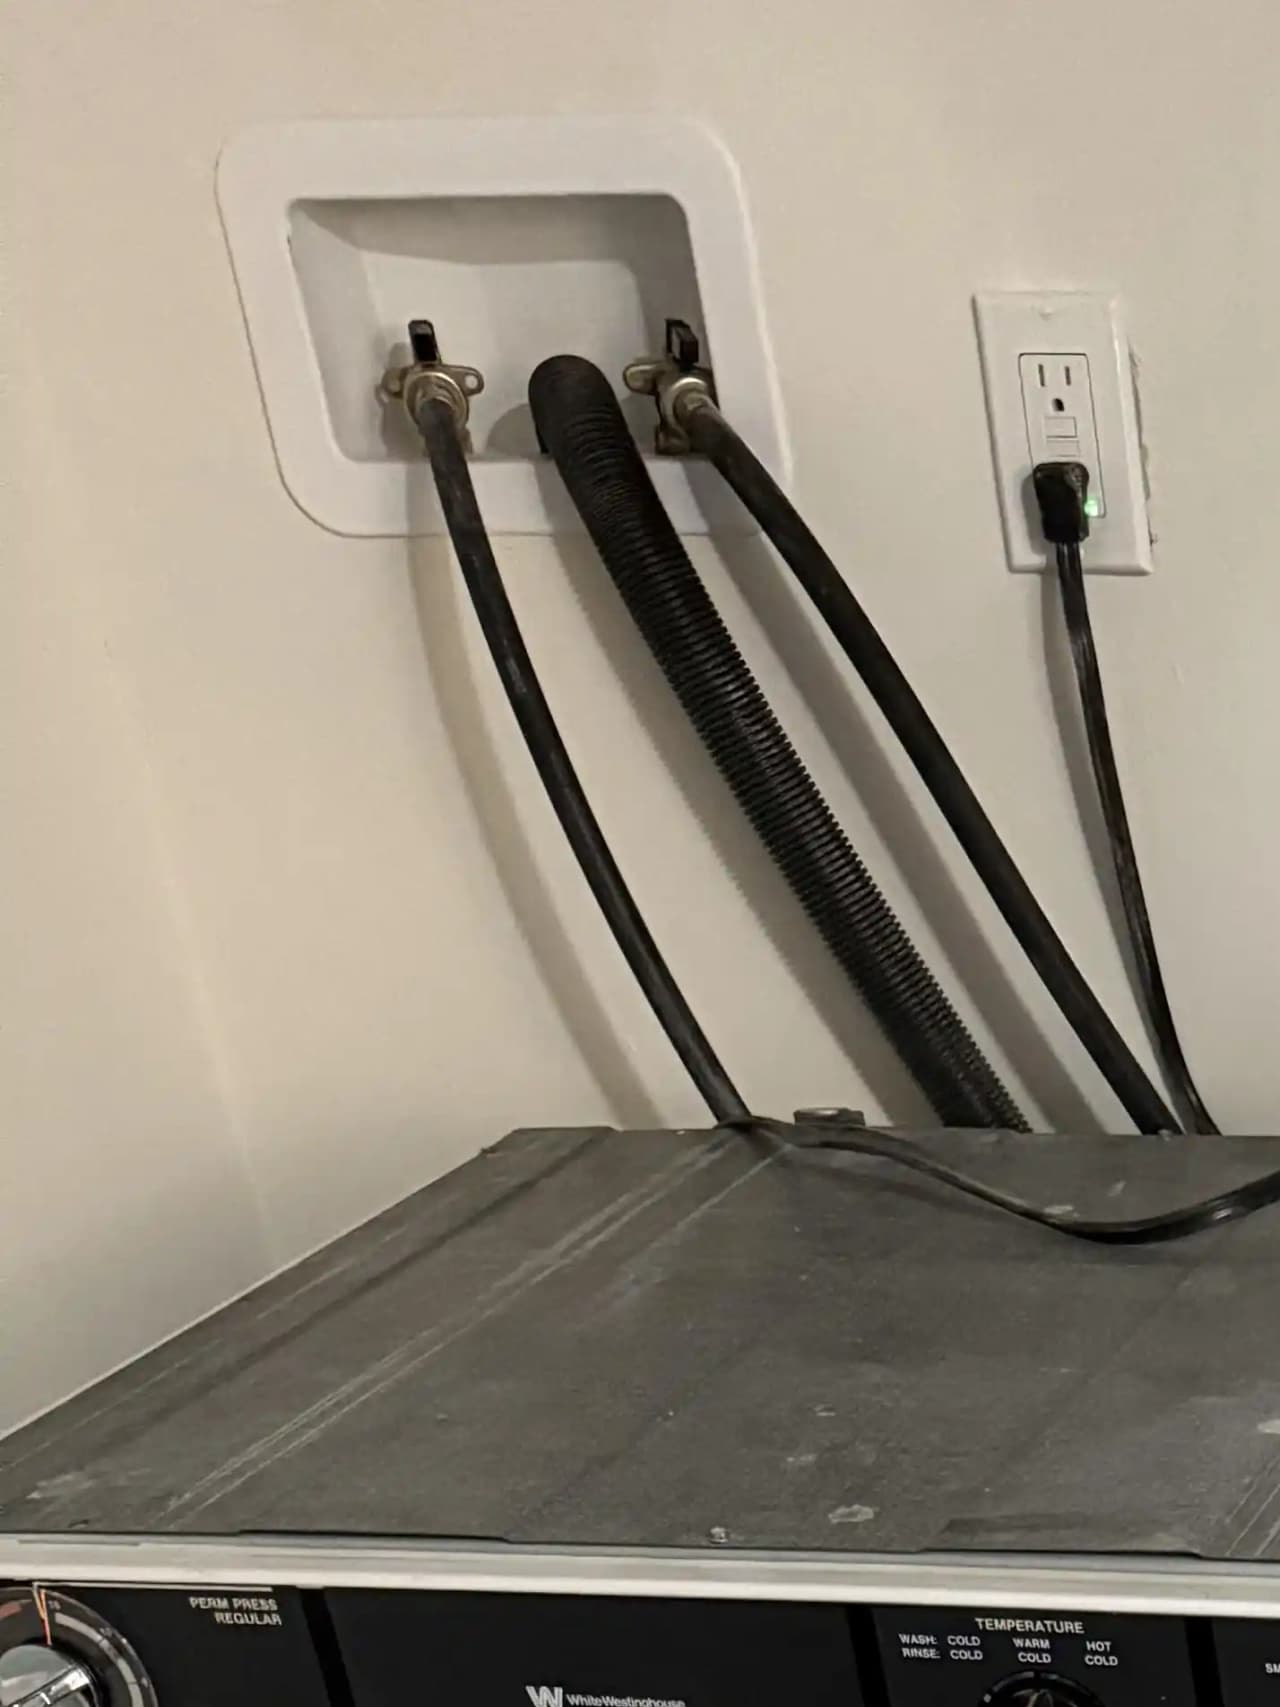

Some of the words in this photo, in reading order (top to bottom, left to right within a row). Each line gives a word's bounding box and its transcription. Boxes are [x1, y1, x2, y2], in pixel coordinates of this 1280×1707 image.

[189, 1597, 229, 1609] PERM
[232, 1598, 278, 1611] PRESS
[214, 1612, 282, 1625] REGULAR
[975, 1618, 1084, 1633] TEMPERATURE
[947, 1635, 980, 1646] COLD
[1013, 1638, 1050, 1649] WARM
[1086, 1641, 1111, 1652] HOT
[950, 1650, 983, 1660] COLD
[1018, 1652, 1051, 1663] COLD
[1085, 1655, 1118, 1666] COLD
